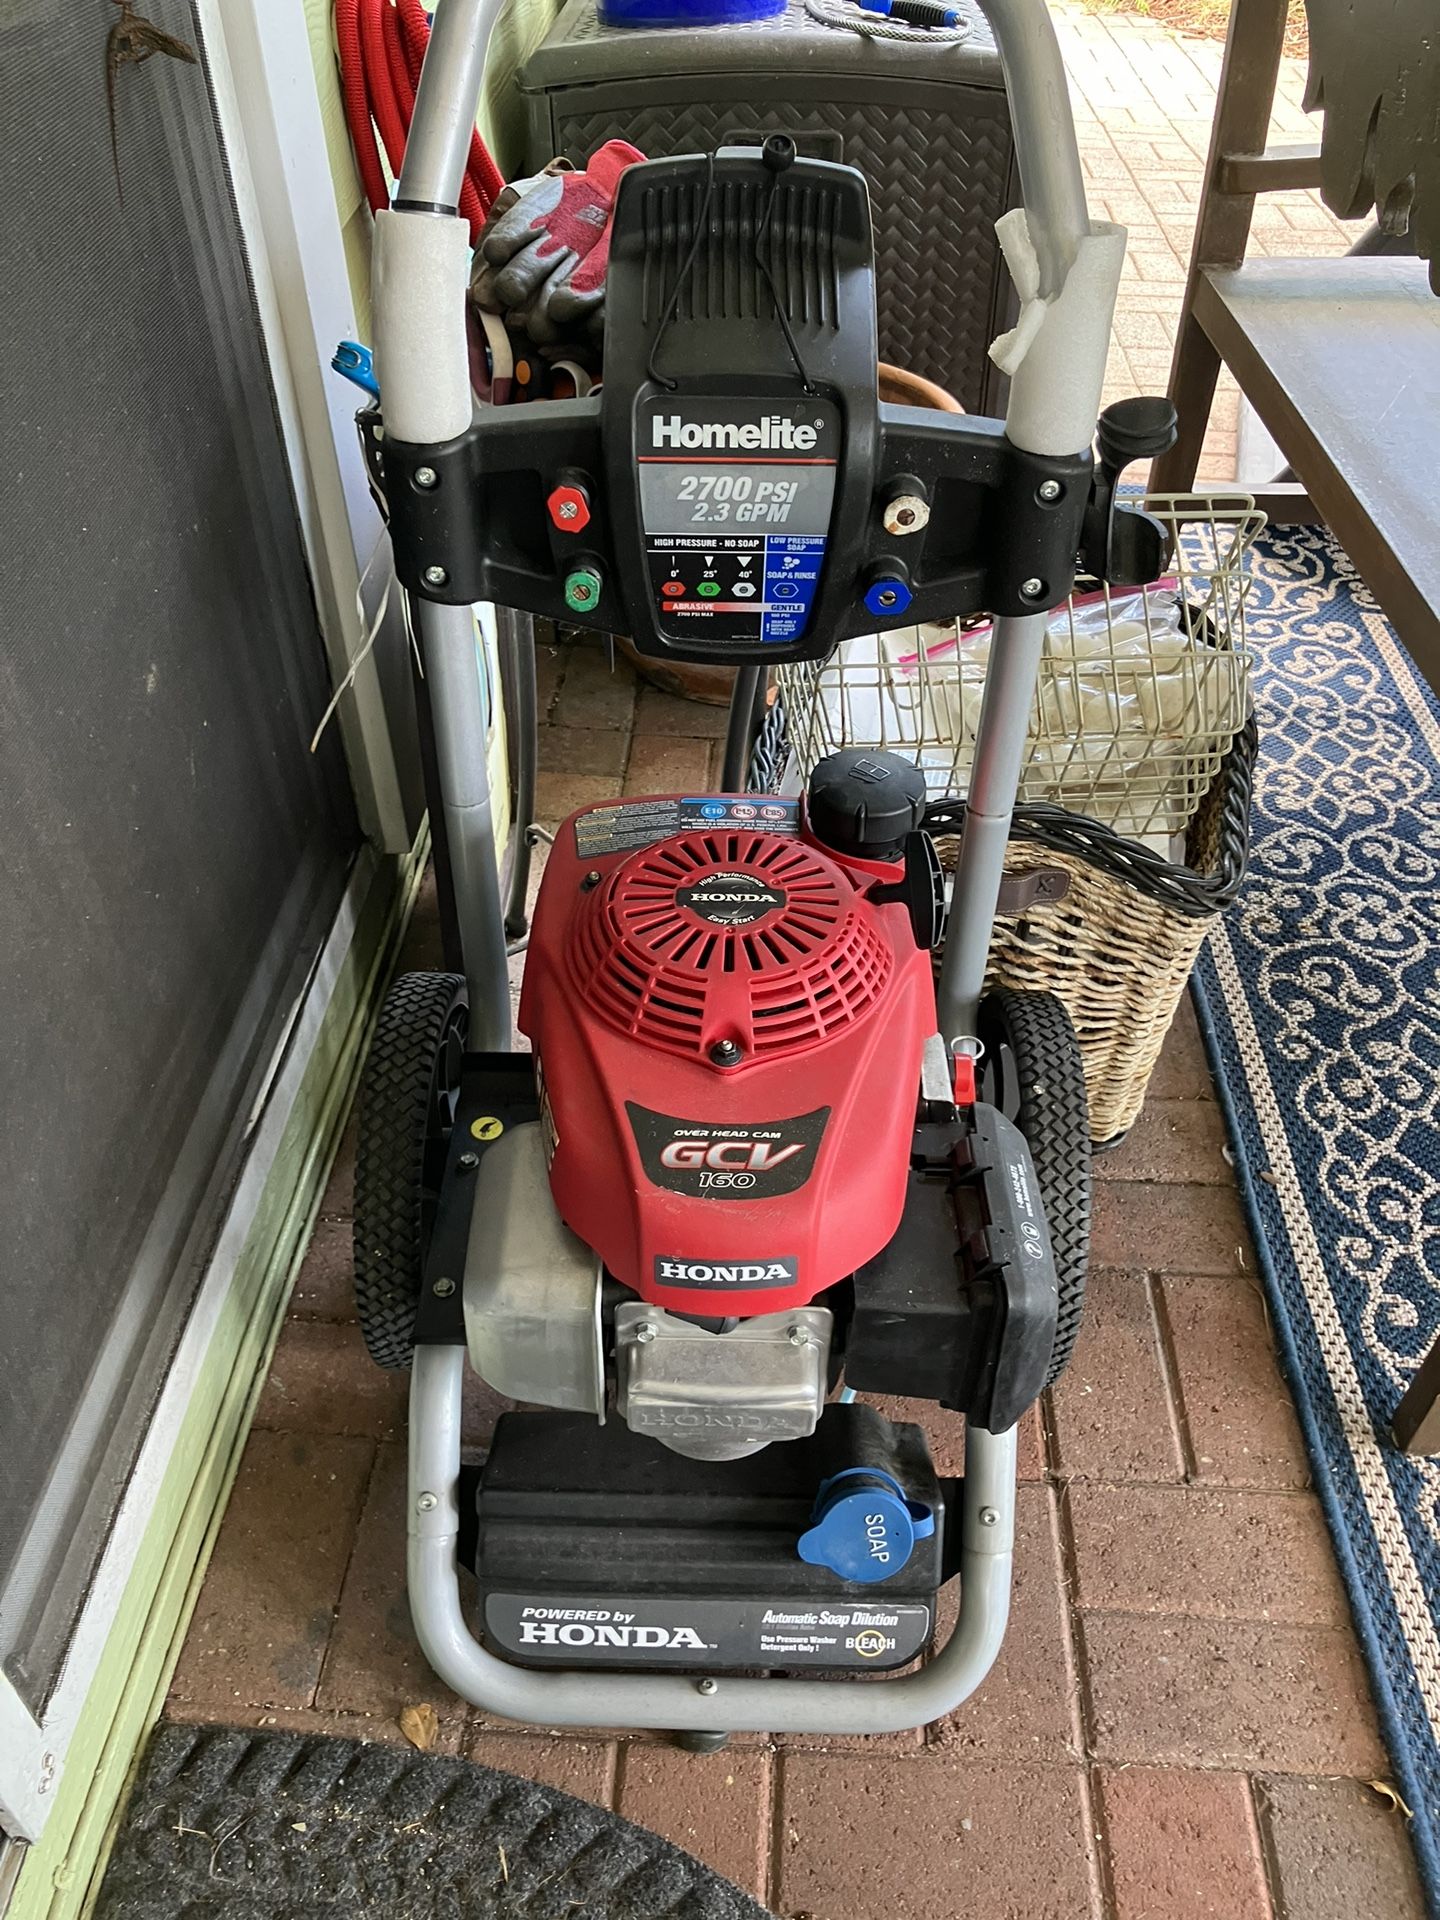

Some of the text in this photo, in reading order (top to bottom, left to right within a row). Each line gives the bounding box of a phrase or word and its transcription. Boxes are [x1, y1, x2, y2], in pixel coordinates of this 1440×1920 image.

[677, 476, 798, 503] 2700 PSI
[691, 503, 792, 522] 2.3 GPM
[654, 538, 674, 546] HIGH
[675, 539, 717, 548] PRESSURE
[787, 537, 824, 545] PRESSURE
[703, 569, 718, 578] 25°
[738, 570, 752, 579] 40°
[766, 571, 787, 579] SOAP
[794, 572, 817, 580] RINSE
[672, 602, 714, 610] ABRASIVE
[705, 807, 723, 815] E10
[699, 871, 766, 888] High Performance
[690, 893, 778, 903] HONDA
[707, 914, 756, 925] Easy Start
[673, 1129, 782, 1139] OVER HEAD CAM
[660, 1141, 806, 1171] GCV
[699, 1172, 756, 1189] 160
[660, 1262, 792, 1282] HONDA
[641, 1408, 800, 1430] HONDA
[865, 1514, 890, 1563] SOAP
[522, 1607, 635, 1624] POWERED by
[762, 1609, 899, 1628] Automatic Soap Dilution
[776, 1635, 808, 1643] Pressure
[810, 1636, 837, 1644] Washer
[845, 1637, 896, 1650] BLEACH
[760, 1643, 797, 1652] Detergent
[798, 1644, 814, 1653] Only
